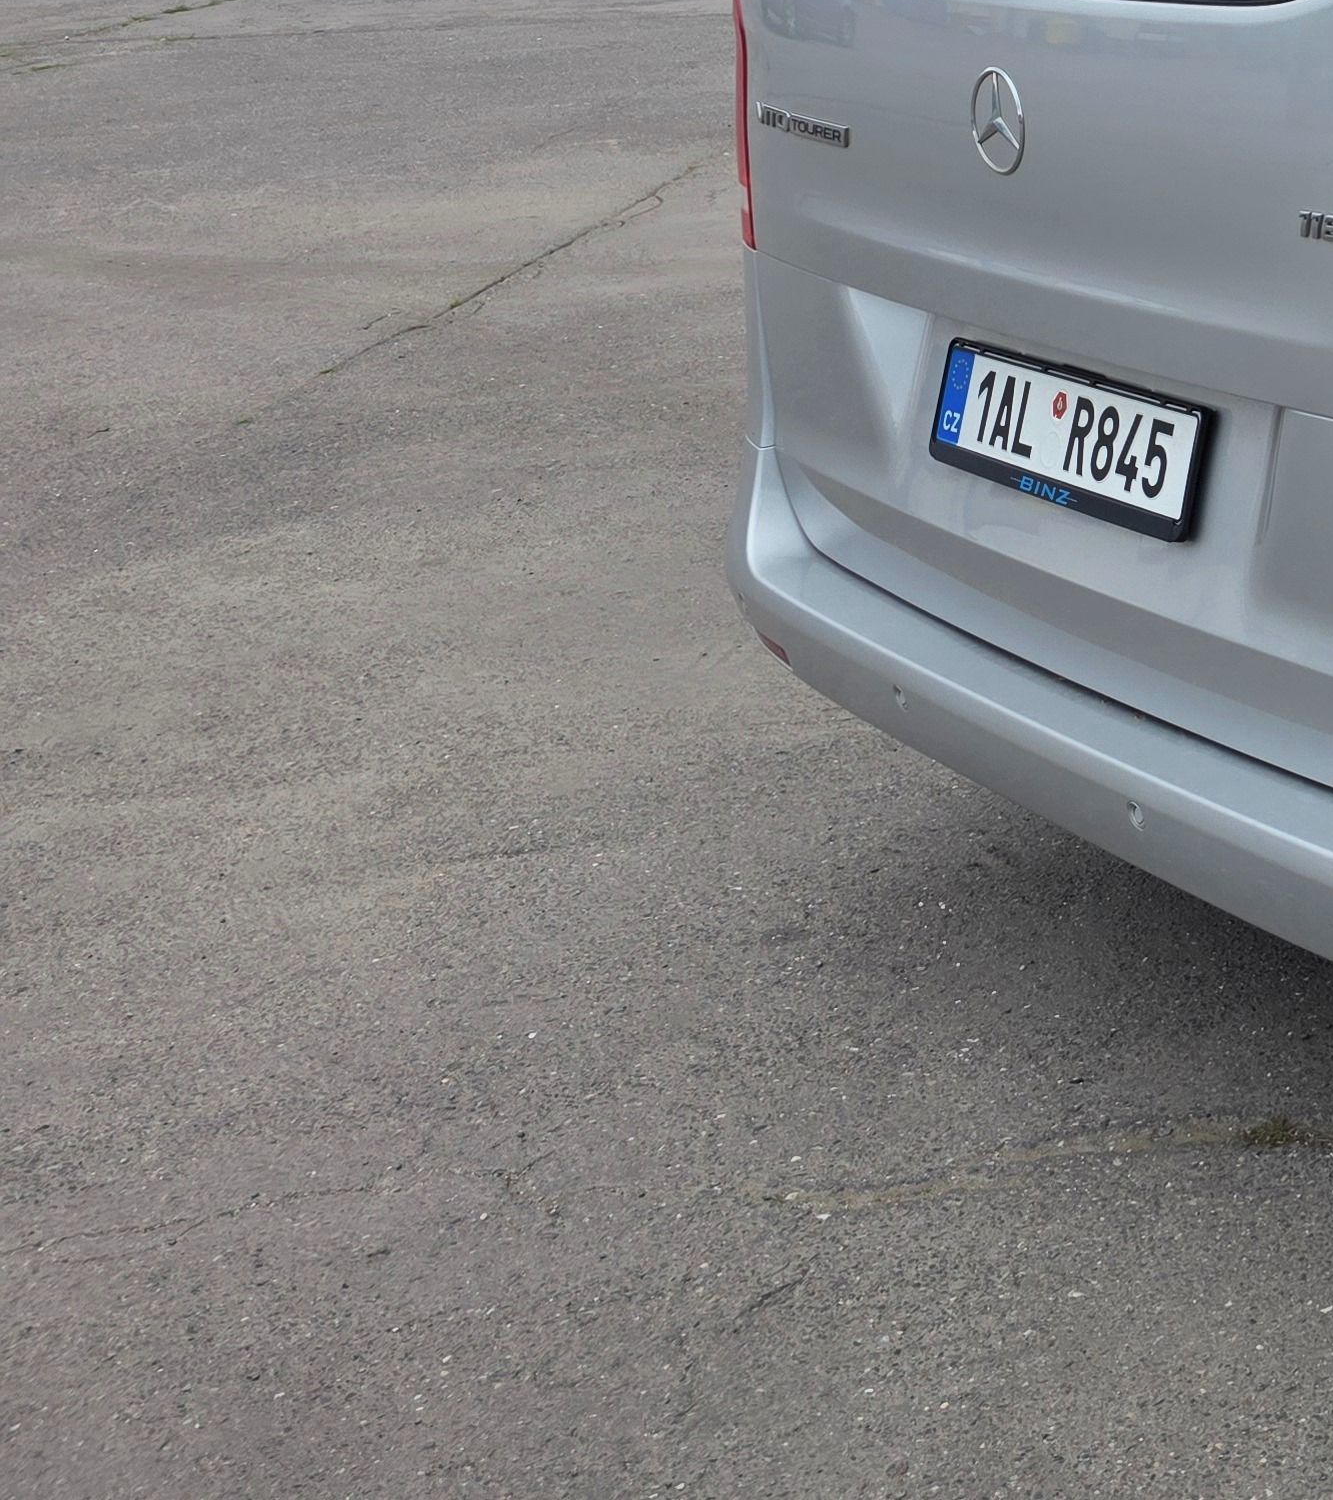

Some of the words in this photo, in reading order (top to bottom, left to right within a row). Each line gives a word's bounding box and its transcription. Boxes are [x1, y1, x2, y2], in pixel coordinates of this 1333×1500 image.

[791, 118, 841, 143] TOURER
[943, 409, 960, 434] CZ
[977, 370, 1032, 459] 1AL
[1062, 395, 1175, 499] R845
[1019, 475, 1071, 506] BINZ
